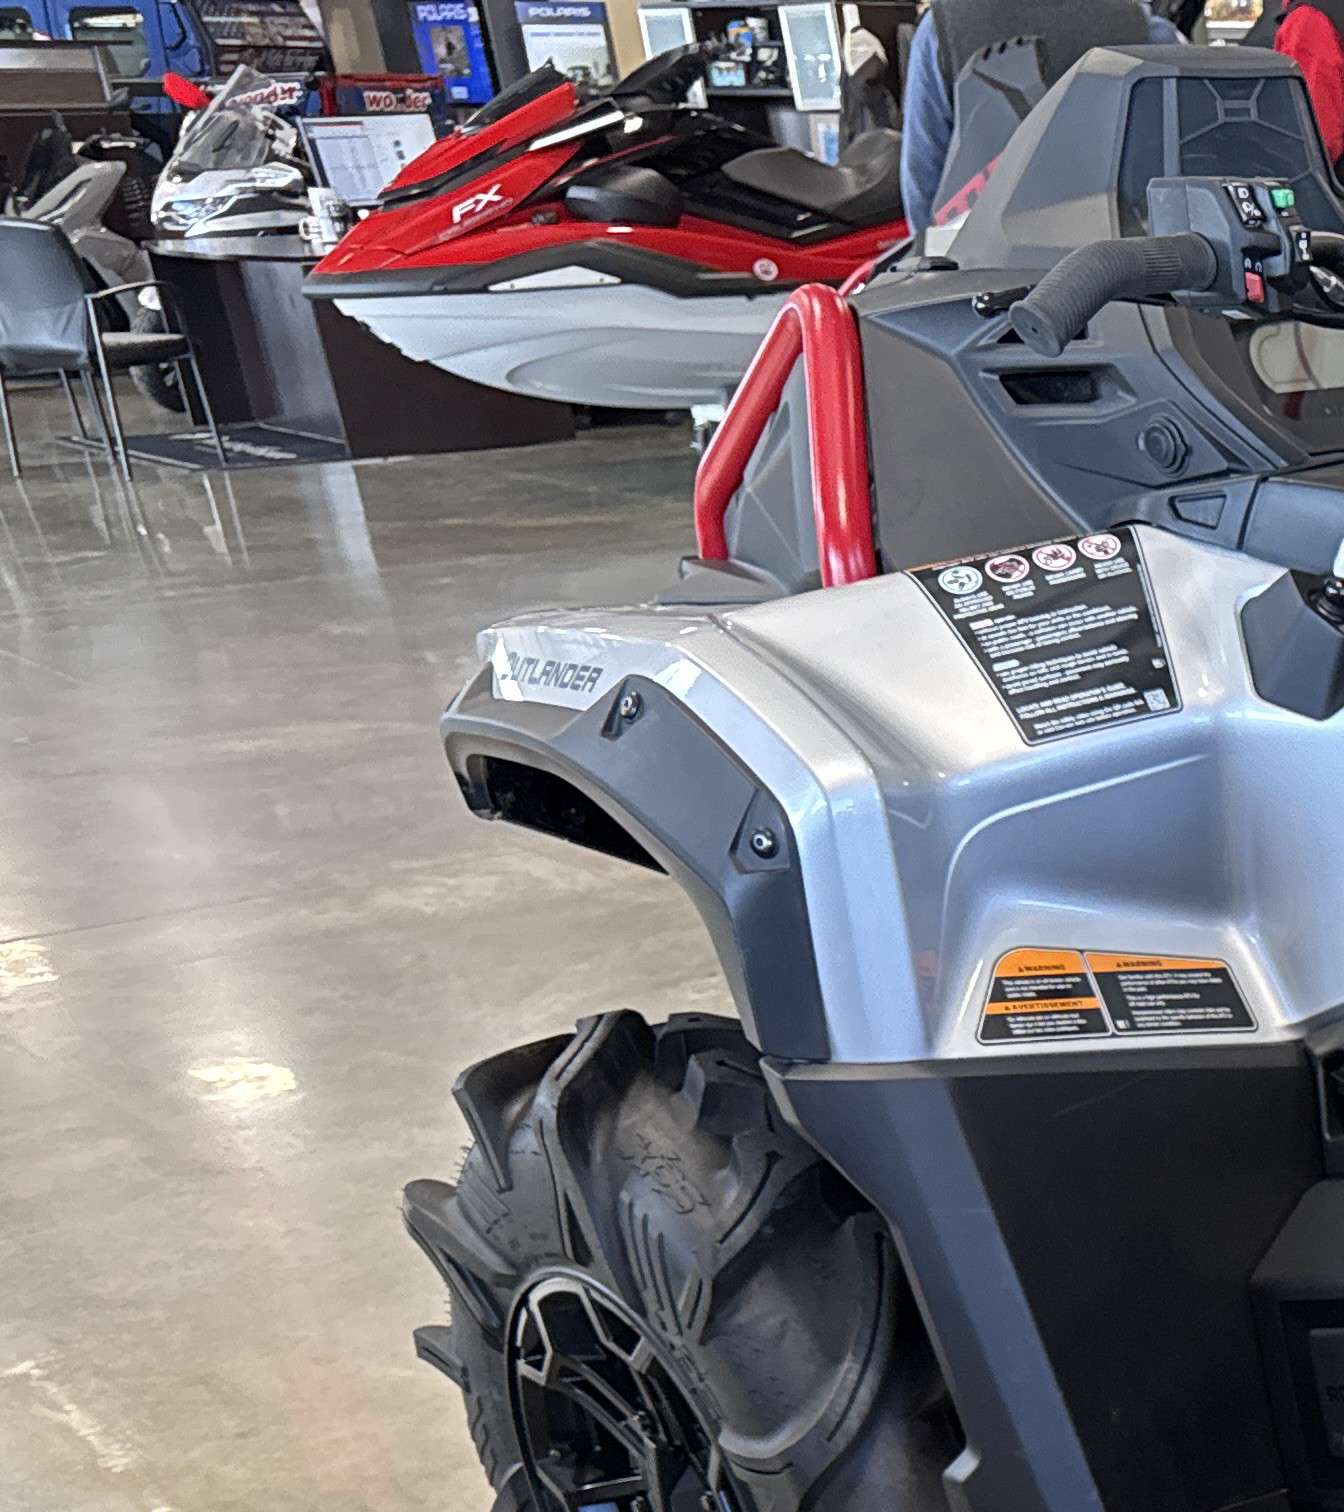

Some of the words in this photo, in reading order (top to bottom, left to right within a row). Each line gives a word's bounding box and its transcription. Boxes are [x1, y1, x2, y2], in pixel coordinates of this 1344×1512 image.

[528, 7, 592, 18] POLARIS
[363, 88, 433, 111] woder
[452, 184, 503, 223] FX
[1024, 963, 1067, 973] WARNING
[1122, 960, 1163, 968] WARNING
